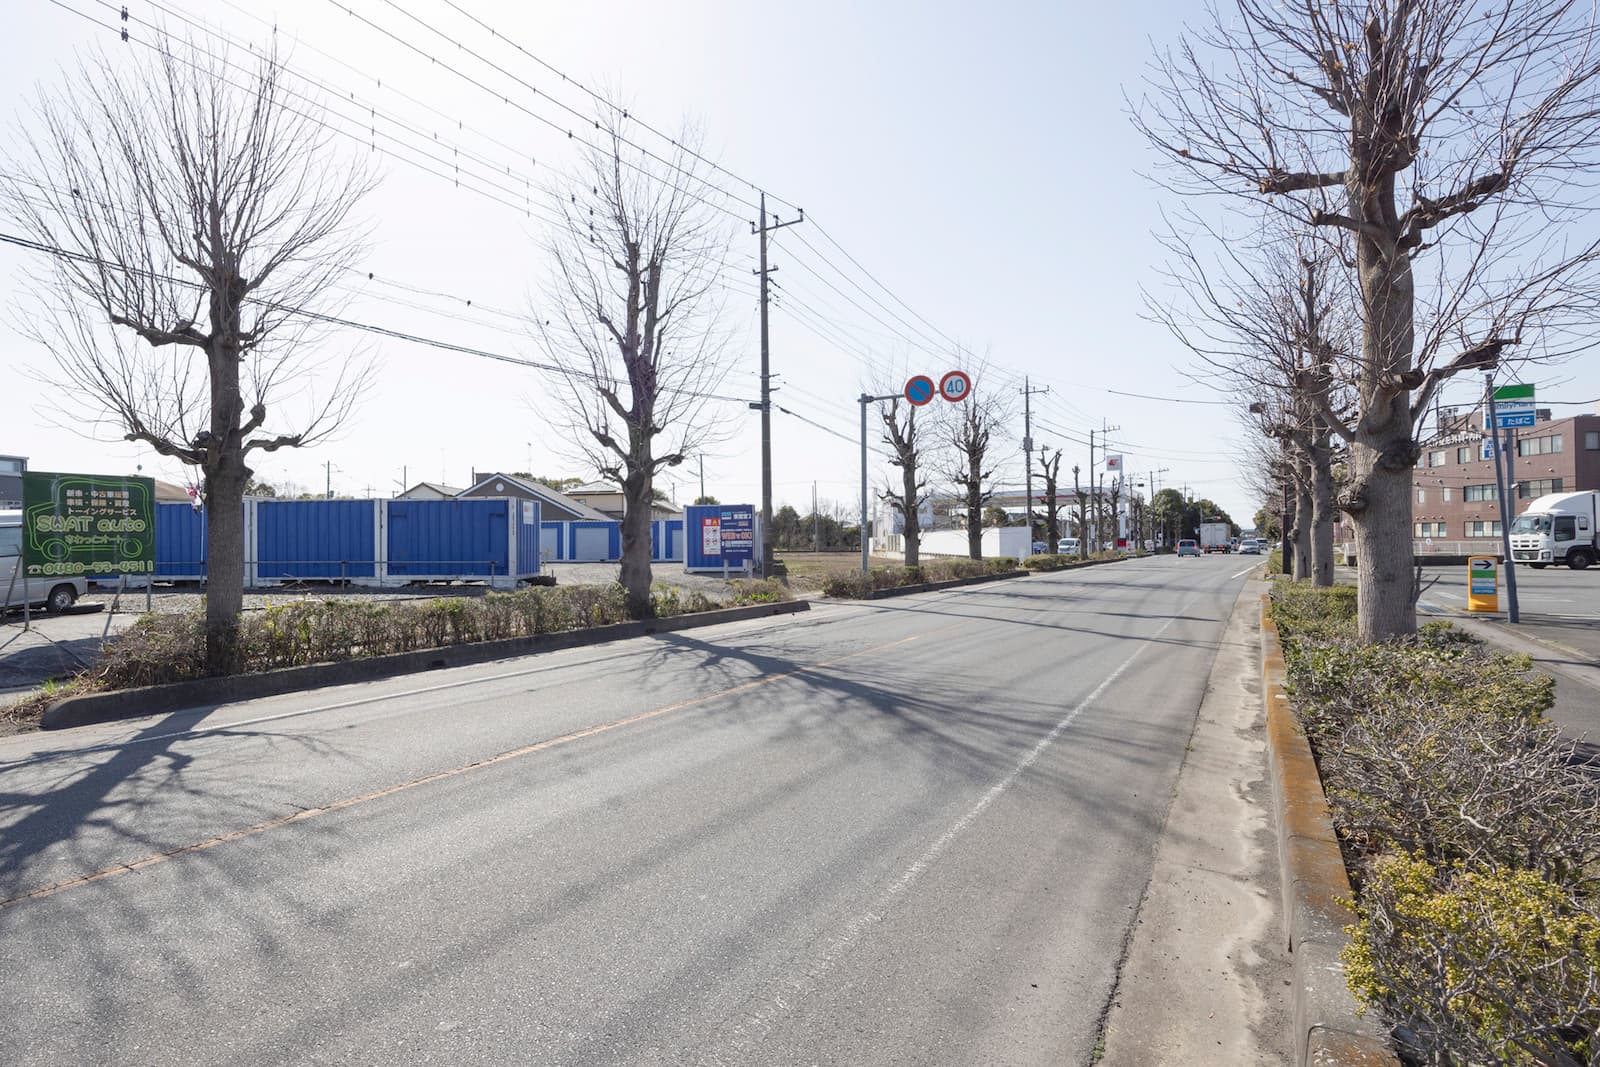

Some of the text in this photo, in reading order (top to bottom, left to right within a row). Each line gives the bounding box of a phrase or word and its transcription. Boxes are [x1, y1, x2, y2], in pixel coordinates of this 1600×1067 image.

[946, 379, 964, 393] 40
[68, 507, 137, 516] トーイングサービス
[37, 515, 146, 532] SWAT auto
